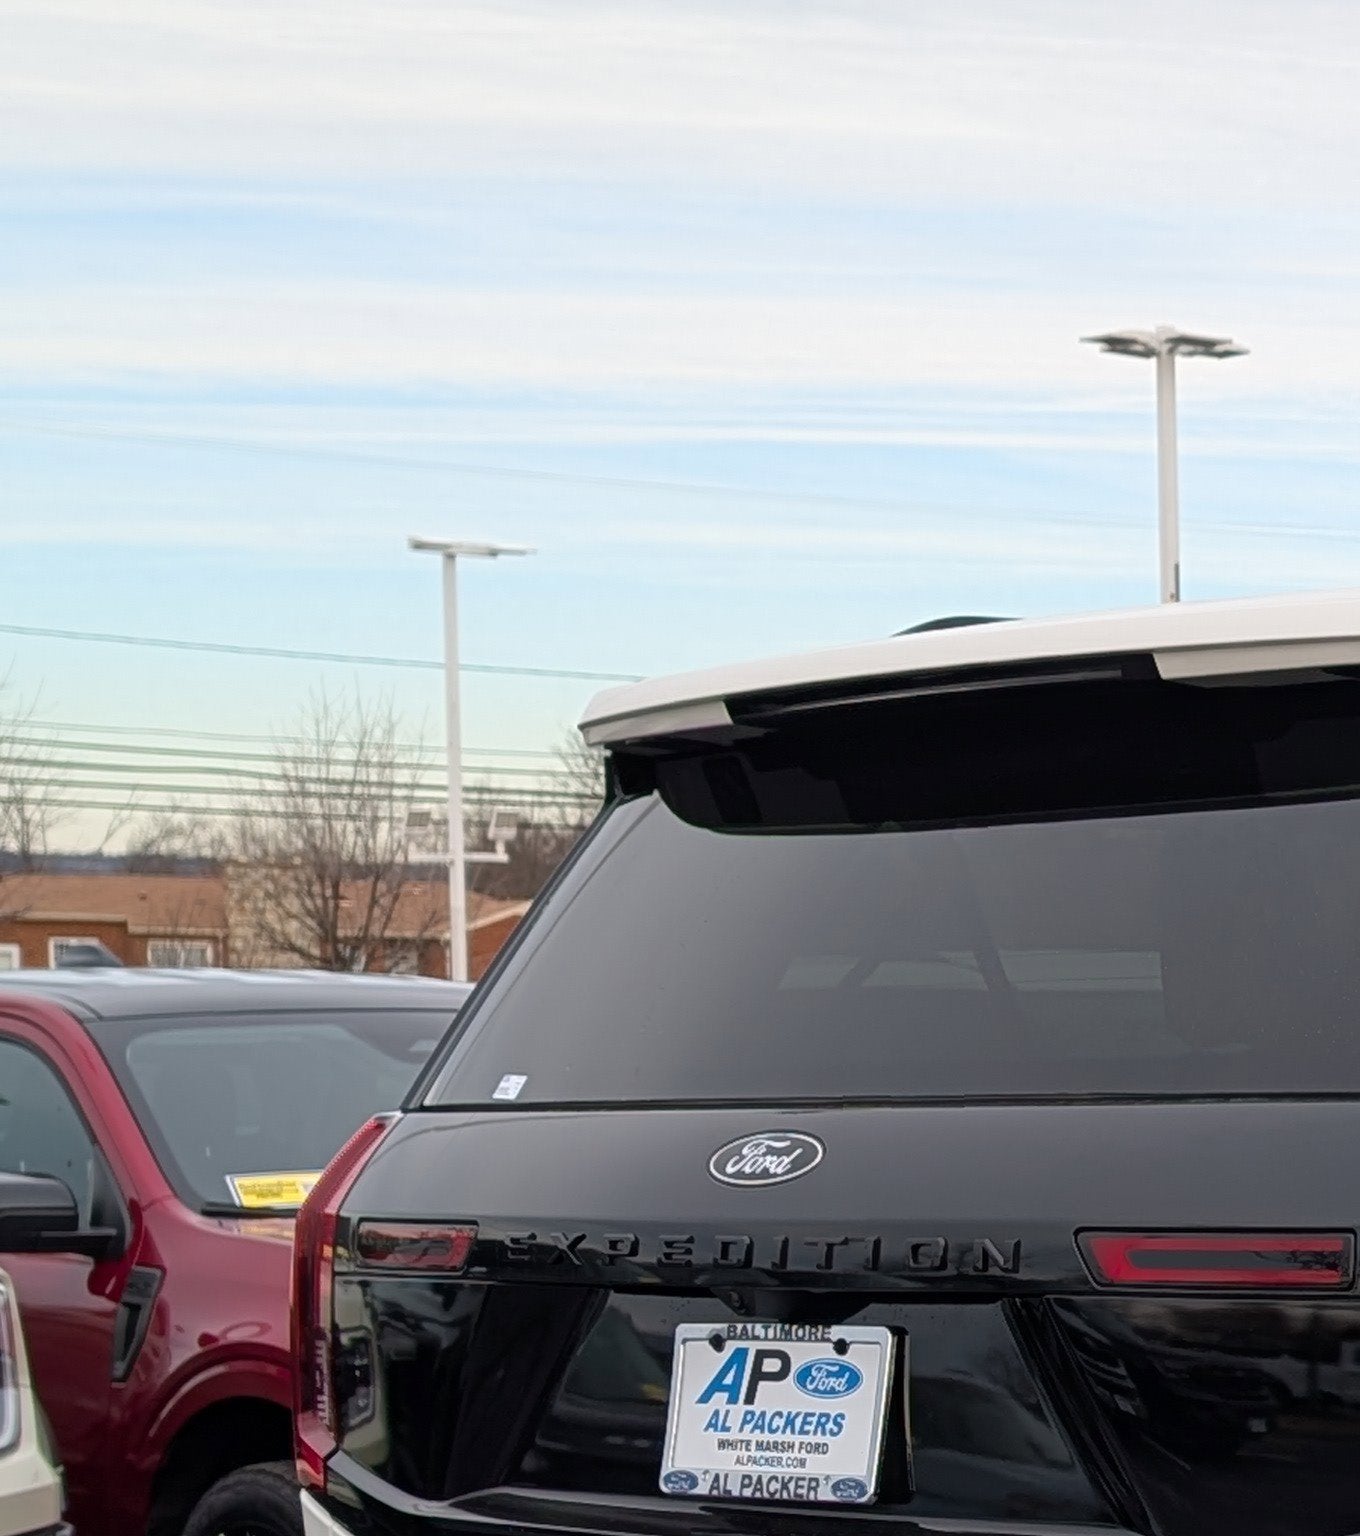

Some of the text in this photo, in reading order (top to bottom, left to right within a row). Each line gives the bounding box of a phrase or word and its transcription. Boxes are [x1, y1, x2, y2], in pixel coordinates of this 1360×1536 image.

[725, 1139, 804, 1175] Ford
[503, 1231, 1023, 1275] EXPEDITION
[726, 1324, 833, 1342] BALTIMORE
[695, 1346, 792, 1406] AP
[703, 1408, 846, 1438] AL PACKERS
[717, 1438, 830, 1456] WHITE MARSH FORD
[734, 1454, 808, 1469] ALPACKER.COM
[707, 1473, 733, 1497] AL
[739, 1473, 821, 1500] PACKER
